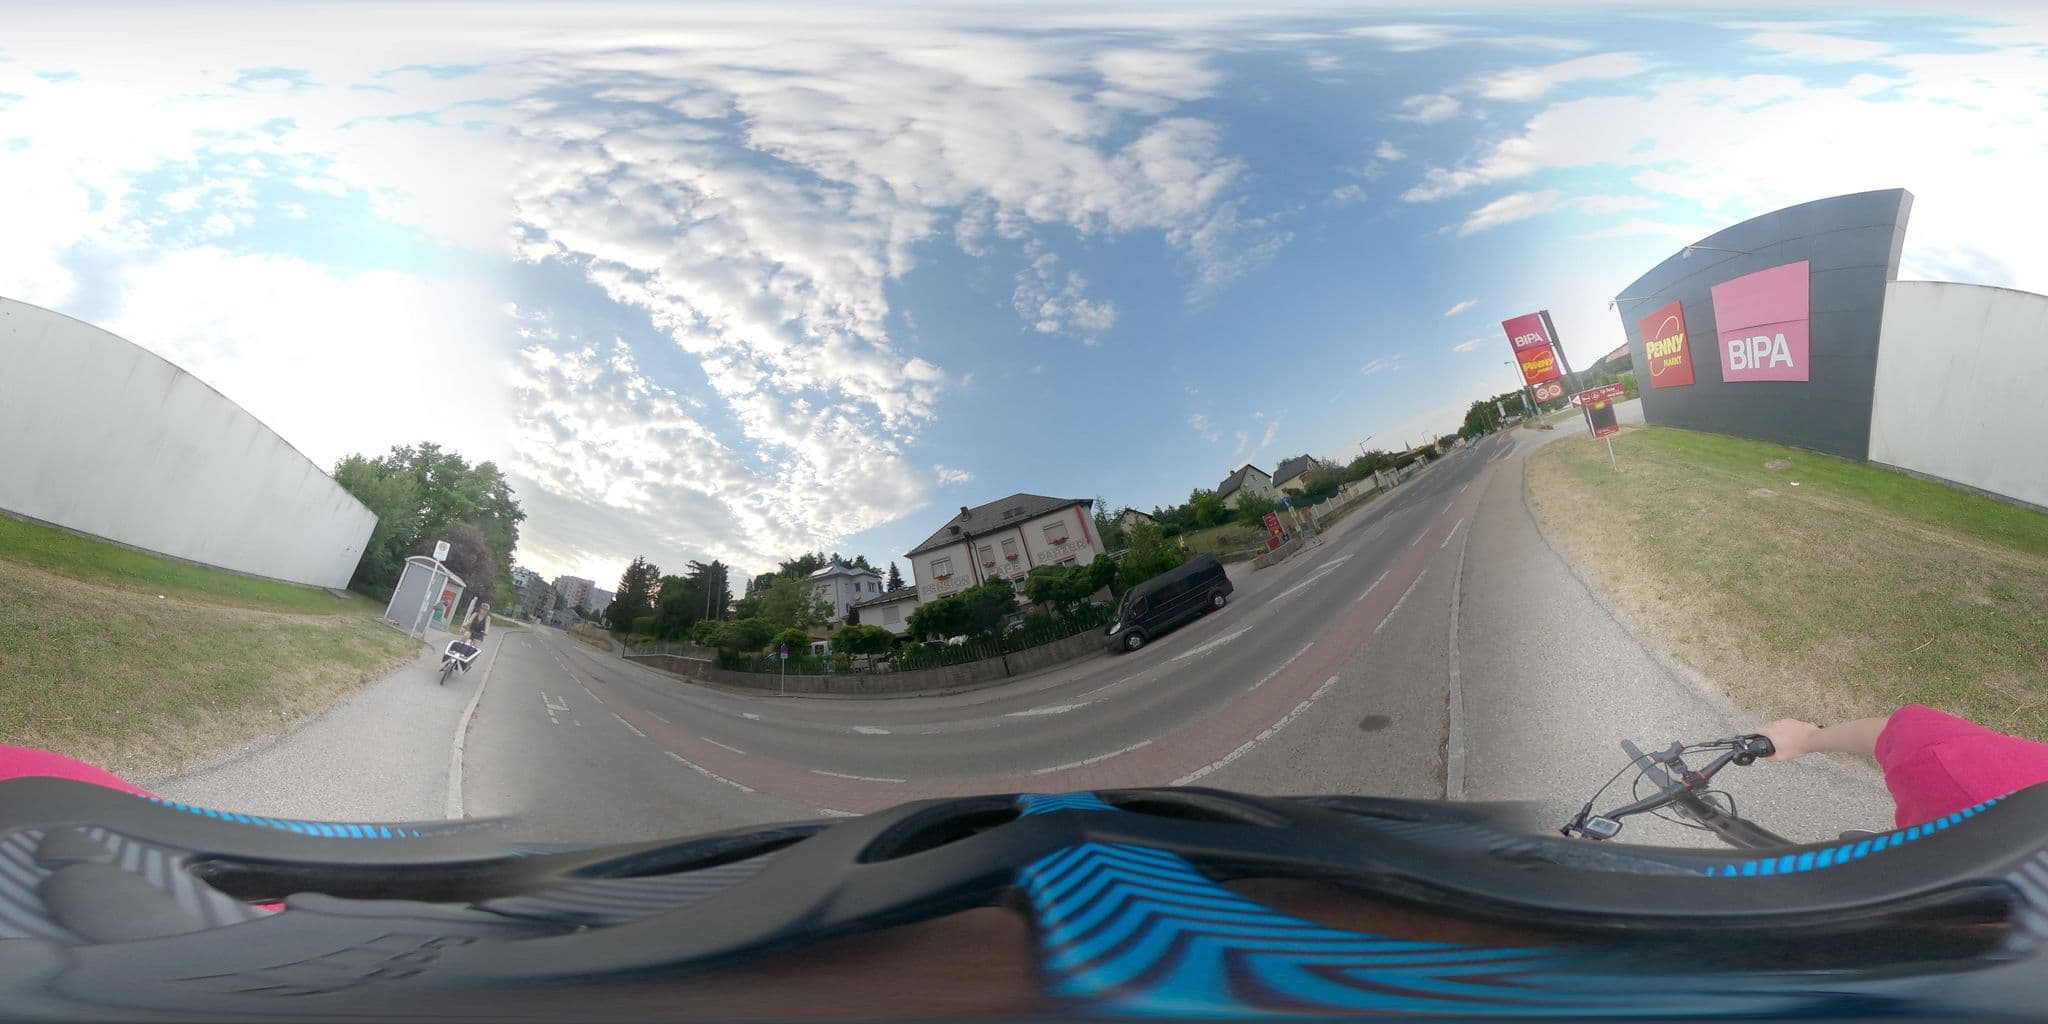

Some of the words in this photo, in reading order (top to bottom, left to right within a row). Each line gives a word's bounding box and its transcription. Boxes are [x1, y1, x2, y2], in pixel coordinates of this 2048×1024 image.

[1515, 333, 1544, 347] BIPA
[1646, 333, 1684, 360] PENNY
[1727, 333, 1794, 370] BIPA
